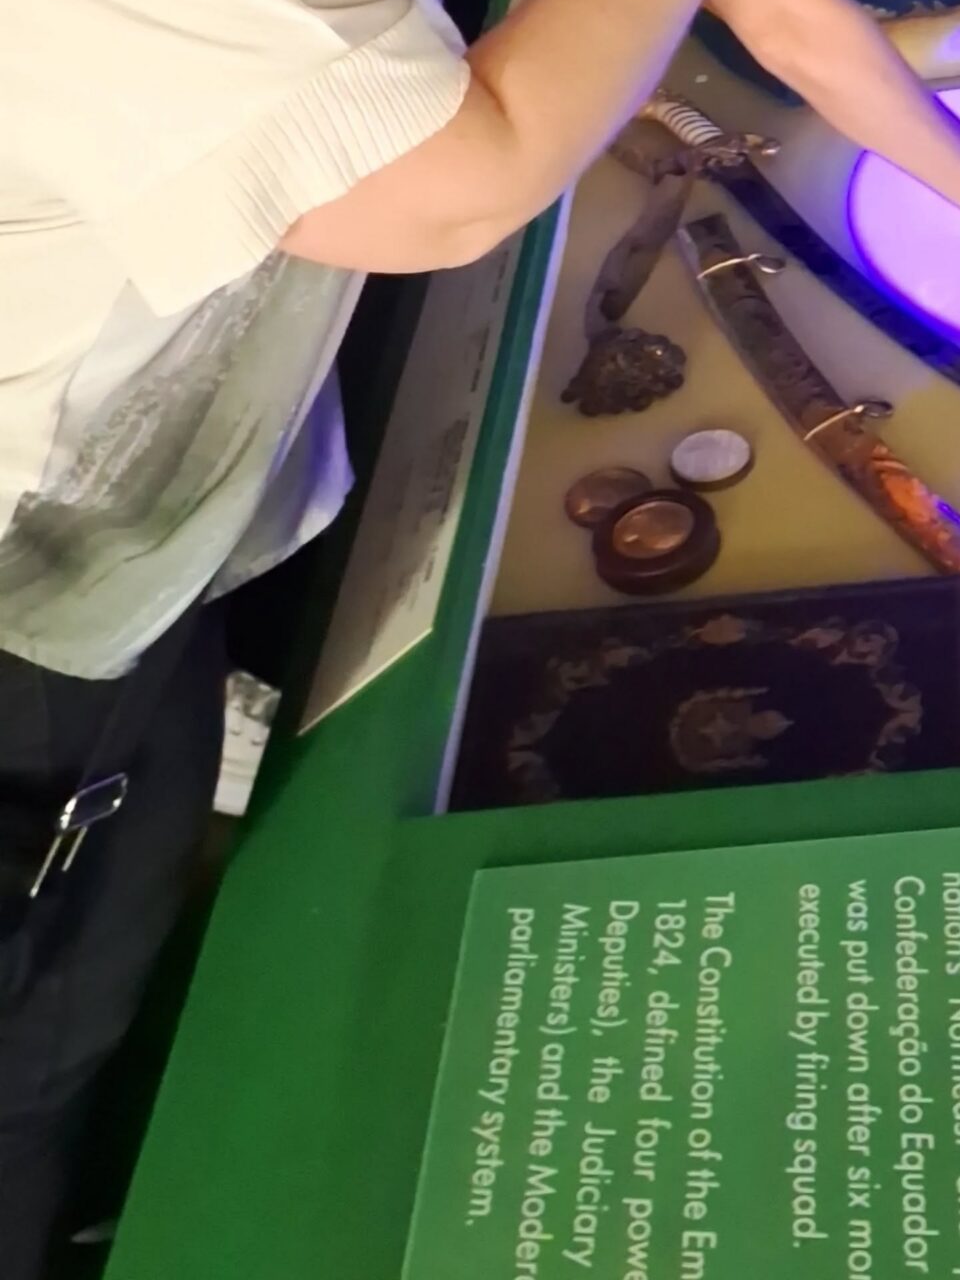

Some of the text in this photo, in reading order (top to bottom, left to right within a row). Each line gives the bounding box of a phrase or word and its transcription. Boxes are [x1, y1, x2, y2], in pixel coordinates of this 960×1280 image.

[647, 899, 687, 974] 1824,
[702, 892, 735, 939] The
[846, 879, 868, 931] was
[539, 904, 591, 1035] Ministers)
[839, 940, 874, 984] put
[466, 908, 538, 1225] parliamentary system.
[640, 991, 680, 1101] defined
[690, 946, 732, 1119] Constitution
[785, 884, 830, 1248] executed by firing squad.
[846, 992, 880, 1072] down
[537, 1043, 569, 1100] and
[562, 901, 640, 1267] Deputies), the Judiciary
[889, 876, 940, 1273] Confederação do Equador
[529, 1108, 567, 1156] the
[633, 1118, 672, 1181] four
[688, 1128, 722, 1161] of
[847, 1083, 882, 1156] after
[683, 1169, 720, 1220] the
[847, 1166, 881, 1208] six
